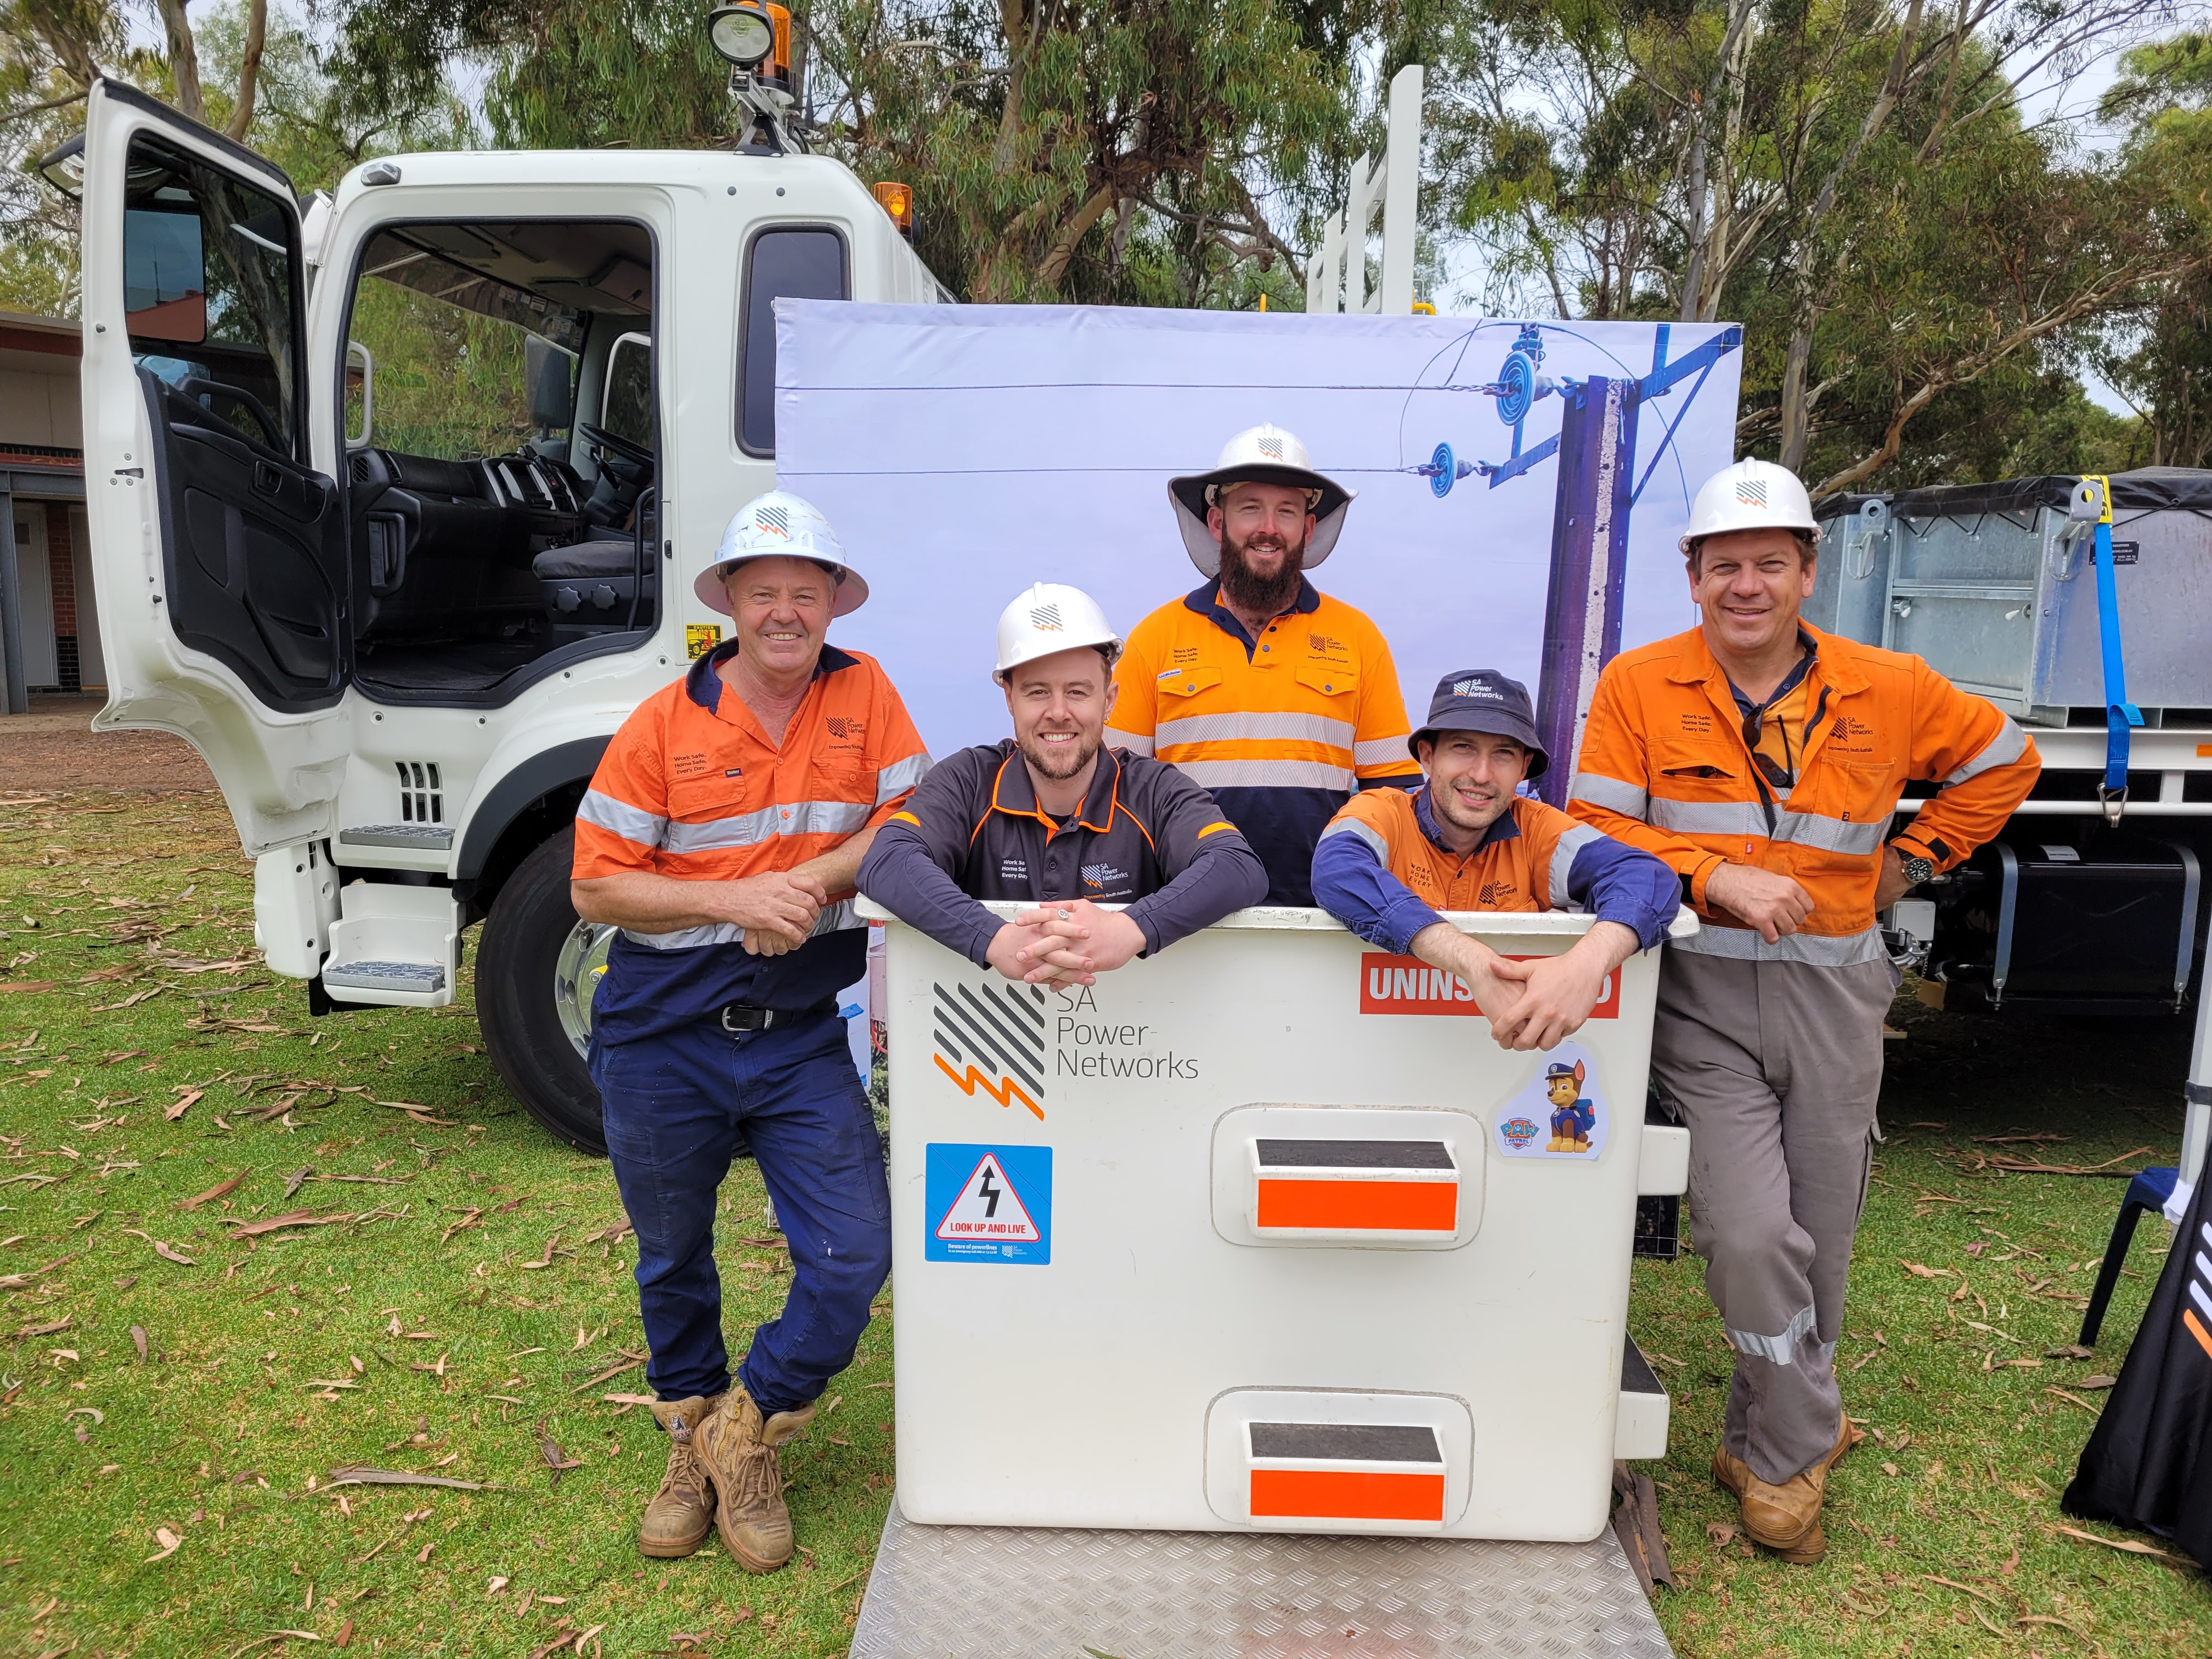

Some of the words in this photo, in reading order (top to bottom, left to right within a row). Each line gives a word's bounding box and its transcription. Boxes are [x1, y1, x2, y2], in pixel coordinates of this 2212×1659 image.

[1468, 691, 1503, 700] Networks
[1411, 862, 1431, 874] WORK
[1102, 872, 1128, 881] Networks
[1410, 870, 1430, 881] HOME
[1409, 876, 1432, 888] EVERY
[1057, 985, 1097, 1012] SA
[1058, 1017, 1149, 1045] Power
[1057, 1048, 1199, 1079] Networks
[1500, 1123, 1540, 1138] PAW
[950, 1222, 973, 1232] LOOK
[974, 1223, 986, 1233] UP
[988, 1224, 1006, 1233] AND
[1008, 1224, 1026, 1234] LIVE
